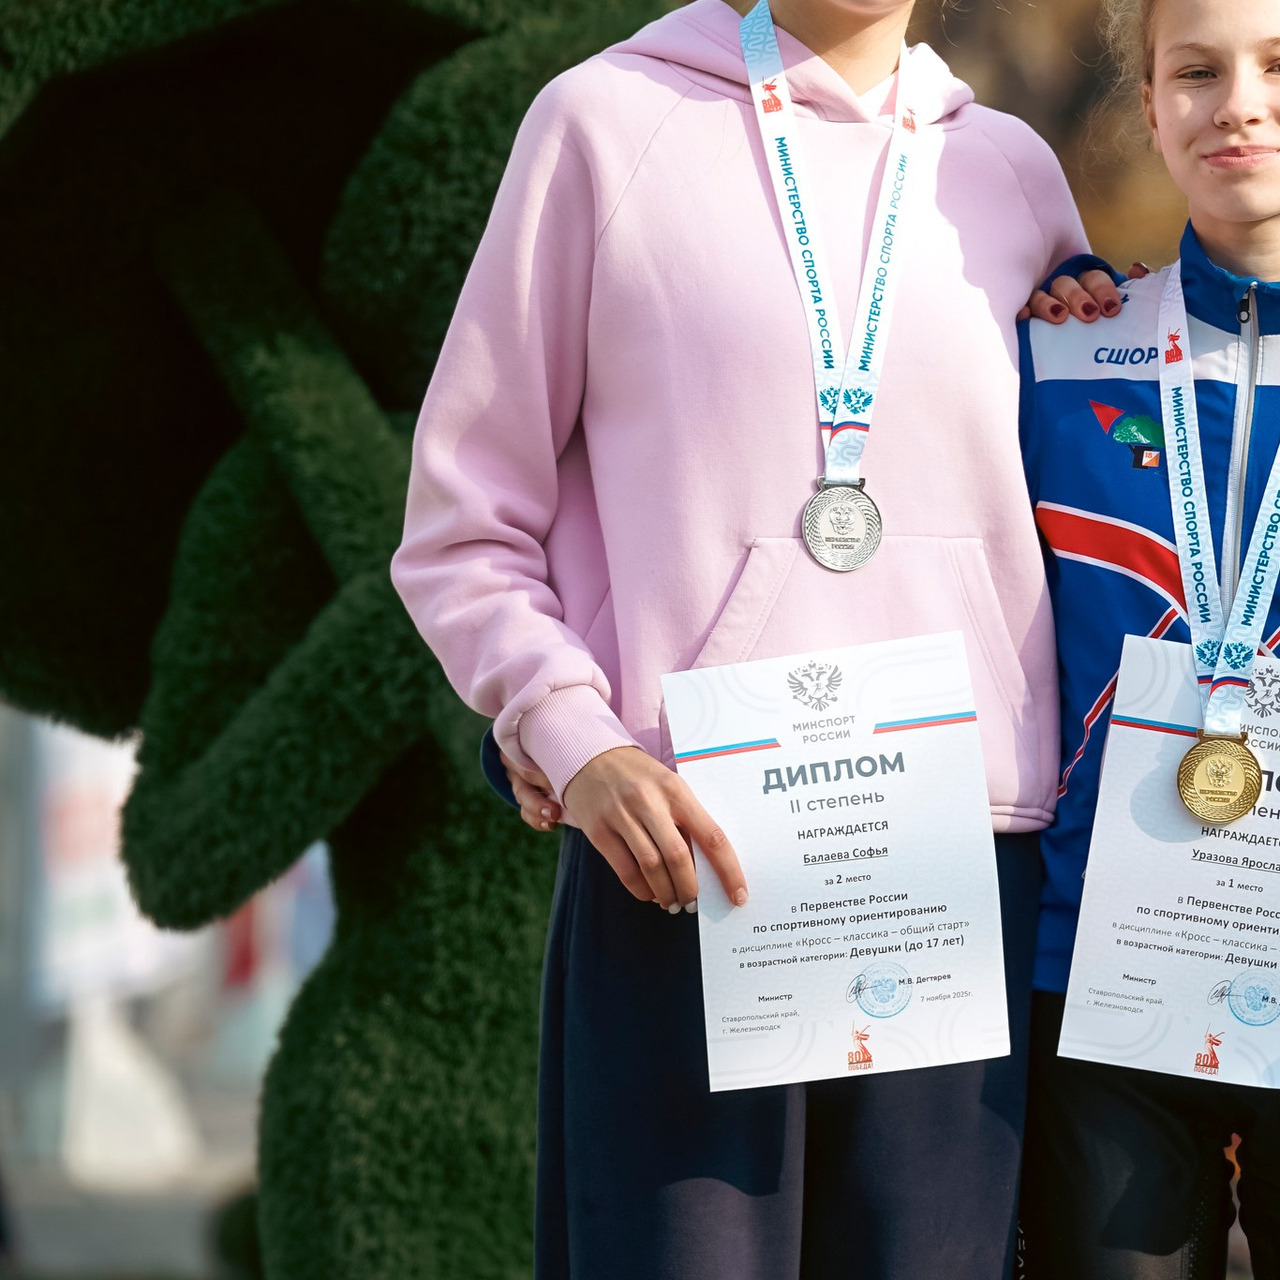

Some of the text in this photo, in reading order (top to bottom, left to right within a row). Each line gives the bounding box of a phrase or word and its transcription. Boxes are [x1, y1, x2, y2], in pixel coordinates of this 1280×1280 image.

[775, 137, 834, 369] МИНИСТЕРСТВО СПОРТА РОССИИ
[858, 154, 907, 371] МИНИСТЕРСТВО СПОРТА РОССИИ
[1094, 347, 1158, 365] СШОР
[1172, 387, 1211, 623] МИНИСТЕРСТВО СПОРТА РОССИИ
[1241, 513, 1280, 626] МИНИСТЕРСТВО
[792, 715, 855, 732] МИНСПОРТ
[802, 729, 850, 744] РОССИИ
[762, 751, 905, 794] ДИПЛОМ
[789, 791, 884, 813] II степень
[797, 820, 888, 840] НАГРАЖДАЕТСЯ
[803, 846, 888, 863] Балаева Софья
[1192, 848, 1238, 864] Уразова
[836, 874, 842, 884] 2
[845, 874, 871, 883] место
[1228, 878, 1233, 888] 1
[1236, 883, 1263, 892] место
[791, 893, 908, 913] в Первенстве России
[1186, 895, 1252, 914] Первенстве
[753, 904, 947, 933] по спортивному ориентированию
[1136, 906, 1150, 915] по
[1153, 909, 1229, 929] спортивному
[738, 941, 792, 954] дисциплине
[795, 936, 831, 948] «Кросс
[843, 930, 888, 942] классика
[899, 922, 934, 935] общий
[937, 921, 969, 931] старт»
[1118, 923, 1172, 936] дисциплине
[1174, 930, 1210, 943] «Кросс
[1221, 938, 1267, 951] классика
[746, 955, 797, 968] возрастной
[799, 952, 847, 962] категории:
[849, 944, 901, 959] Девушки
[904, 940, 923, 953] (до
[926, 937, 939, 948] 17
[942, 934, 964, 946] лет)
[1123, 939, 1173, 952] возрастной
[1175, 948, 1223, 960] категории:
[1224, 952, 1277, 969] Девушки
[915, 974, 951, 984] Дегтярев
[1122, 973, 1156, 985] Министр
[758, 993, 792, 1002] Министр
[926, 993, 951, 1001] ноября
[952, 990, 973, 998] 2025г.
[1088, 987, 1164, 1005] Ставропольский край,
[1092, 999, 1143, 1013] Железноводск
[721, 1009, 799, 1023] Ставропольский край,
[729, 1024, 781, 1033] Железноводск
[847, 1050, 862, 1063] 80
[1194, 1052, 1211, 1066] 80
